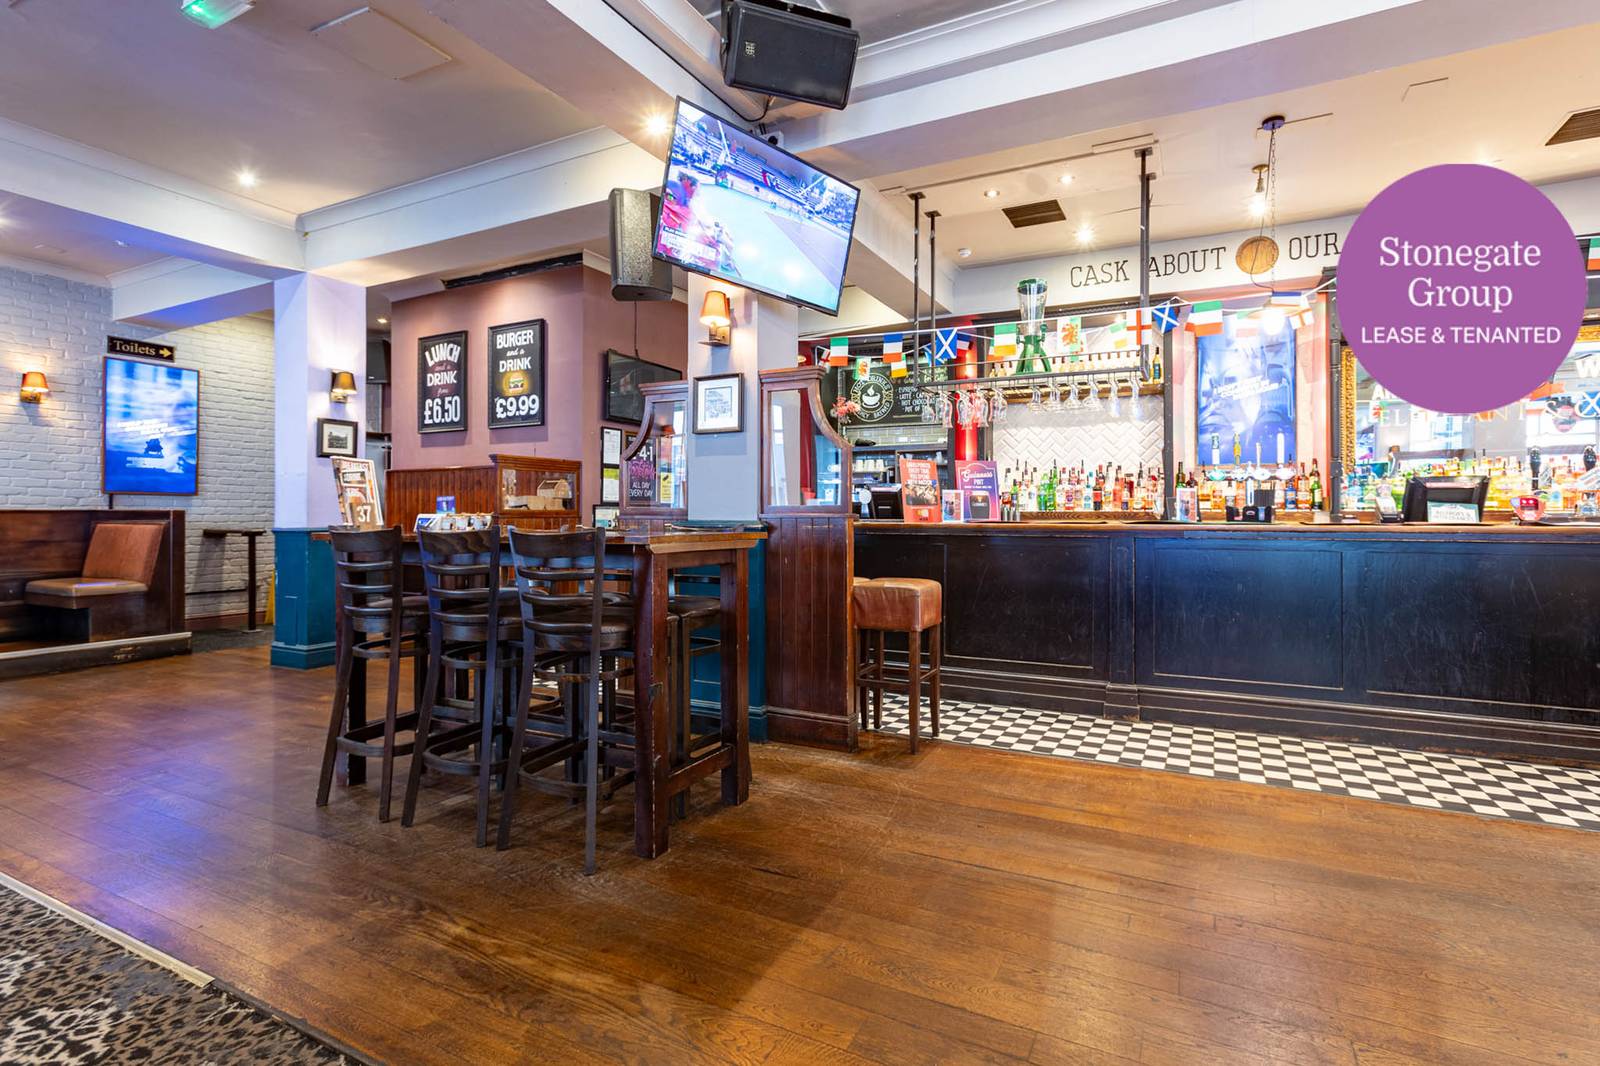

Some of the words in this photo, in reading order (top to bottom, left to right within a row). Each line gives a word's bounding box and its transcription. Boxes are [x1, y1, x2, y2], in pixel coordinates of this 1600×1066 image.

[1070, 260, 1130, 288] CASK
[1148, 246, 1227, 278] ABOUT
[1288, 232, 1341, 261] OUR
[113, 340, 156, 356] Toilets
[496, 330, 534, 349] BURGER
[425, 342, 461, 367] LUNCH
[499, 357, 532, 373] DRINK
[426, 371, 457, 387] DRINK
[424, 395, 461, 424] £6.50
[496, 394, 540, 419] £9.99
[356, 505, 372, 522] 37
